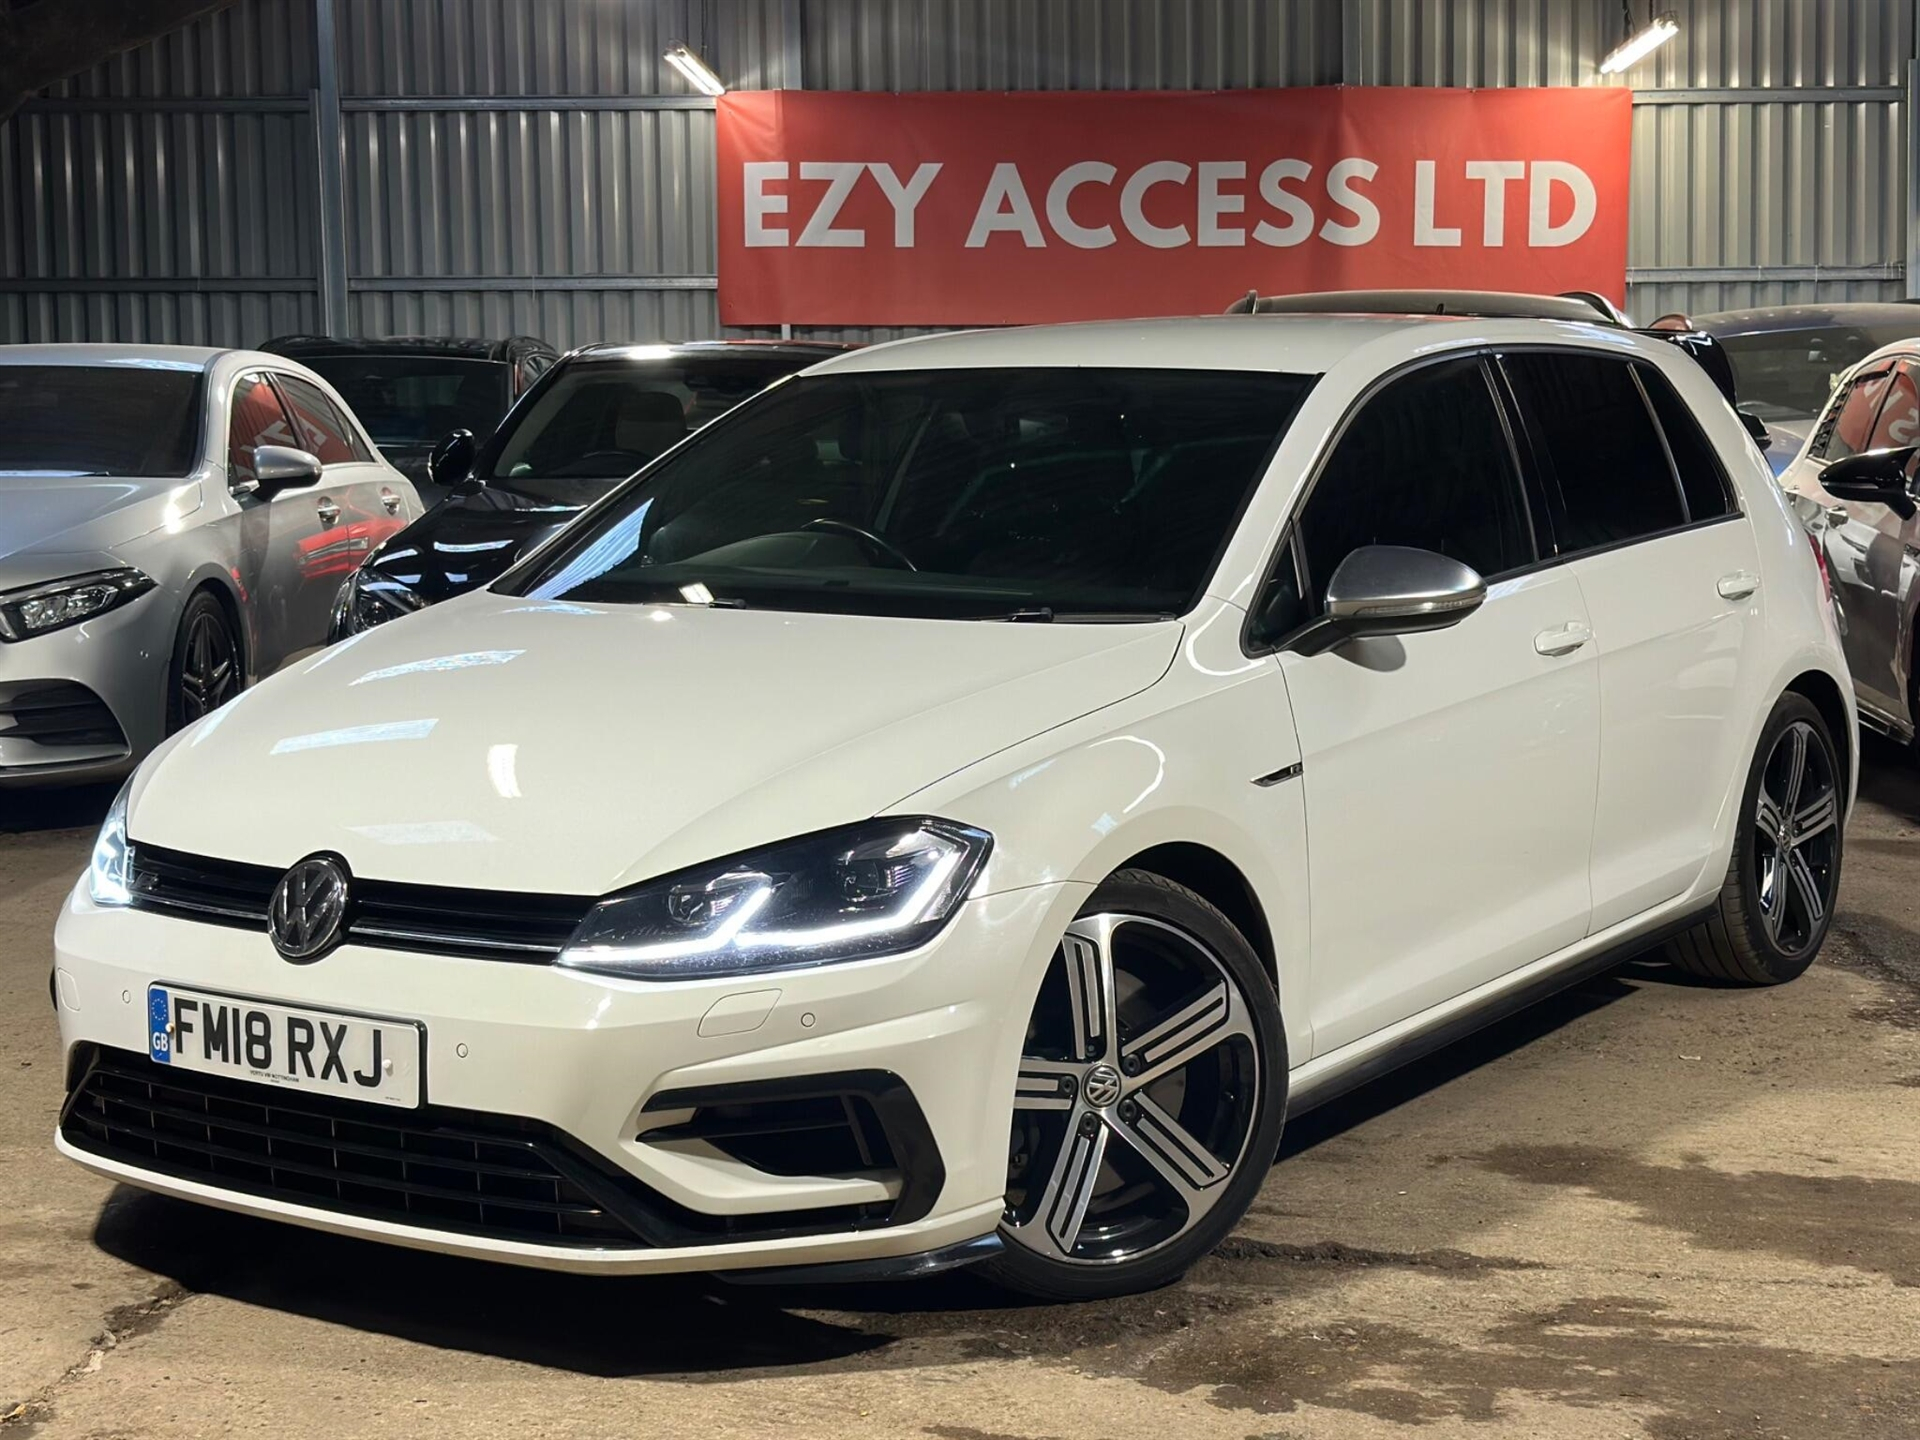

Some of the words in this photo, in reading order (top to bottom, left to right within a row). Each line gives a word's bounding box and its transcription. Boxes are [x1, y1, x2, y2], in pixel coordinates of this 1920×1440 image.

[743, 161, 943, 248] EZY
[965, 158, 1381, 248] ACCESS
[1413, 160, 1598, 248] LTD
[153, 1032, 168, 1051] GB
[174, 998, 271, 1069] FM18
[287, 1017, 381, 1088] RXJ
